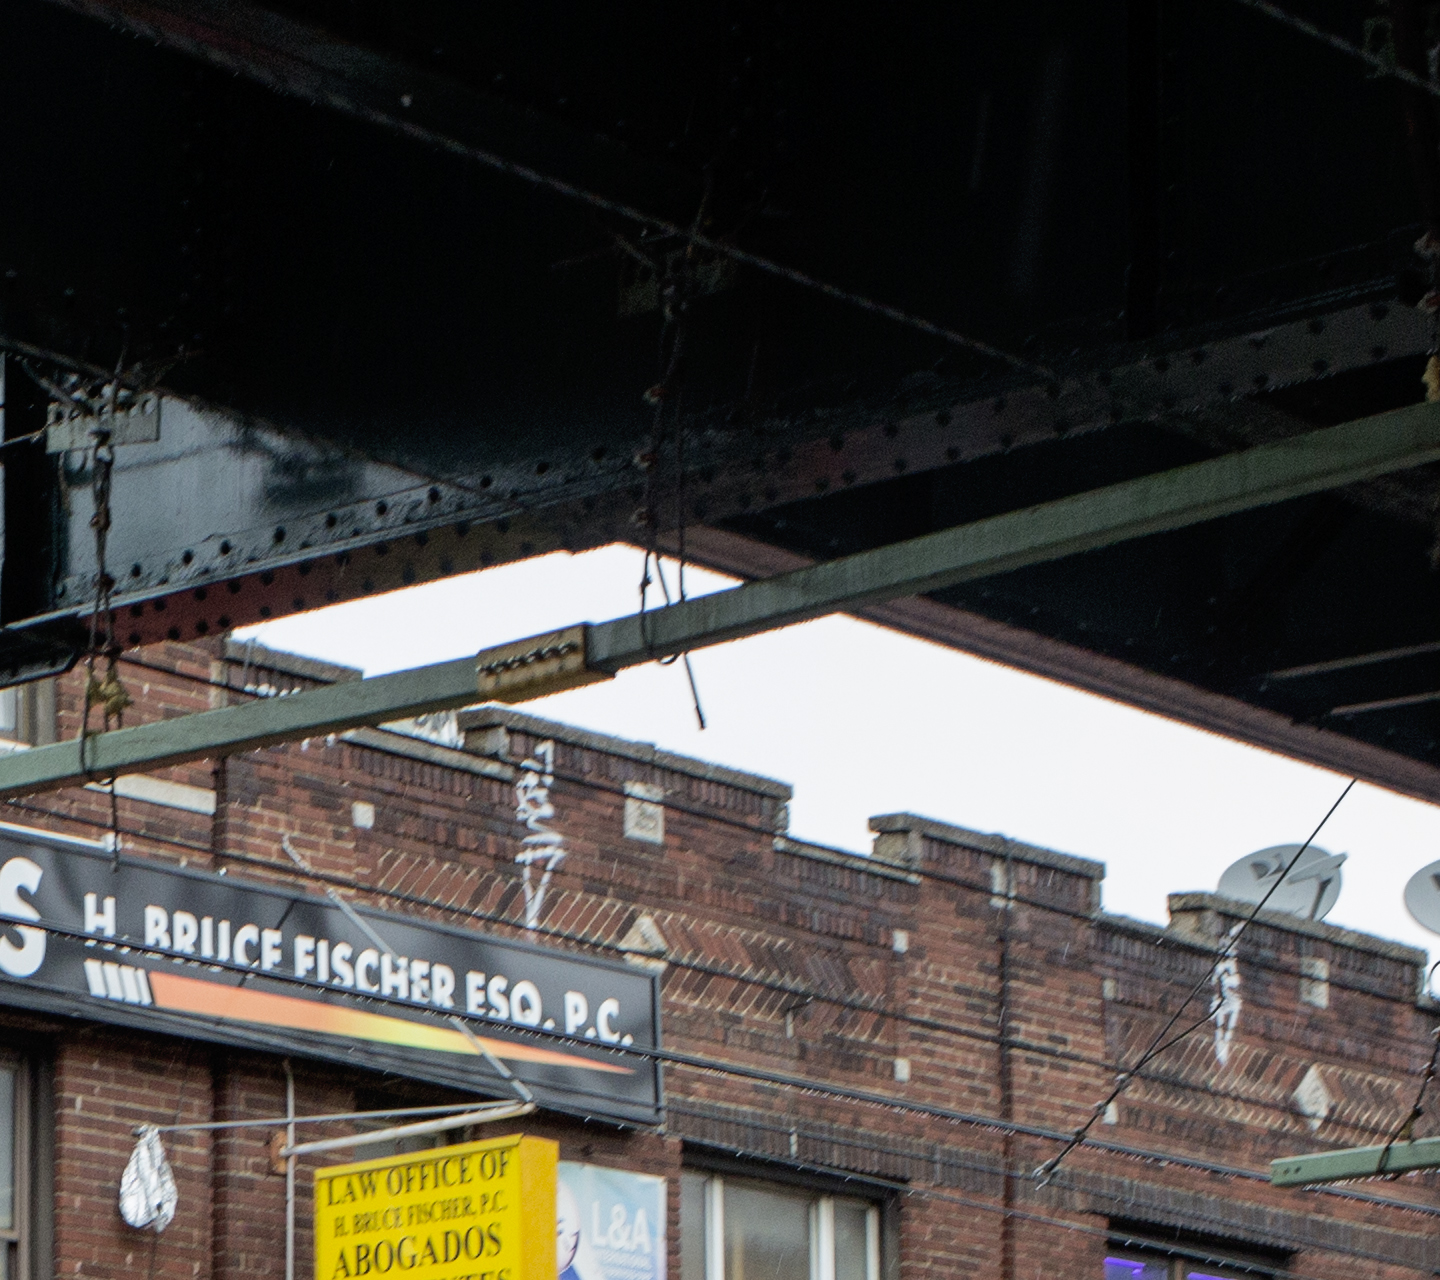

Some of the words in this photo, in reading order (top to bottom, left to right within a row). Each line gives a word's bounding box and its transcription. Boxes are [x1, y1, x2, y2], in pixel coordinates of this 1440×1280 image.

[144, 905, 282, 970] BRUCE
[294, 935, 454, 1009] FISCHER
[466, 971, 556, 1030] ESQ.
[565, 991, 634, 1048] P.C.
[326, 1172, 377, 1206] LAW
[386, 1157, 472, 1197] OFFICE
[481, 1151, 511, 1181] OF
[353, 1206, 403, 1234] BRUCE
[332, 1222, 502, 1280] ABOGADOS
